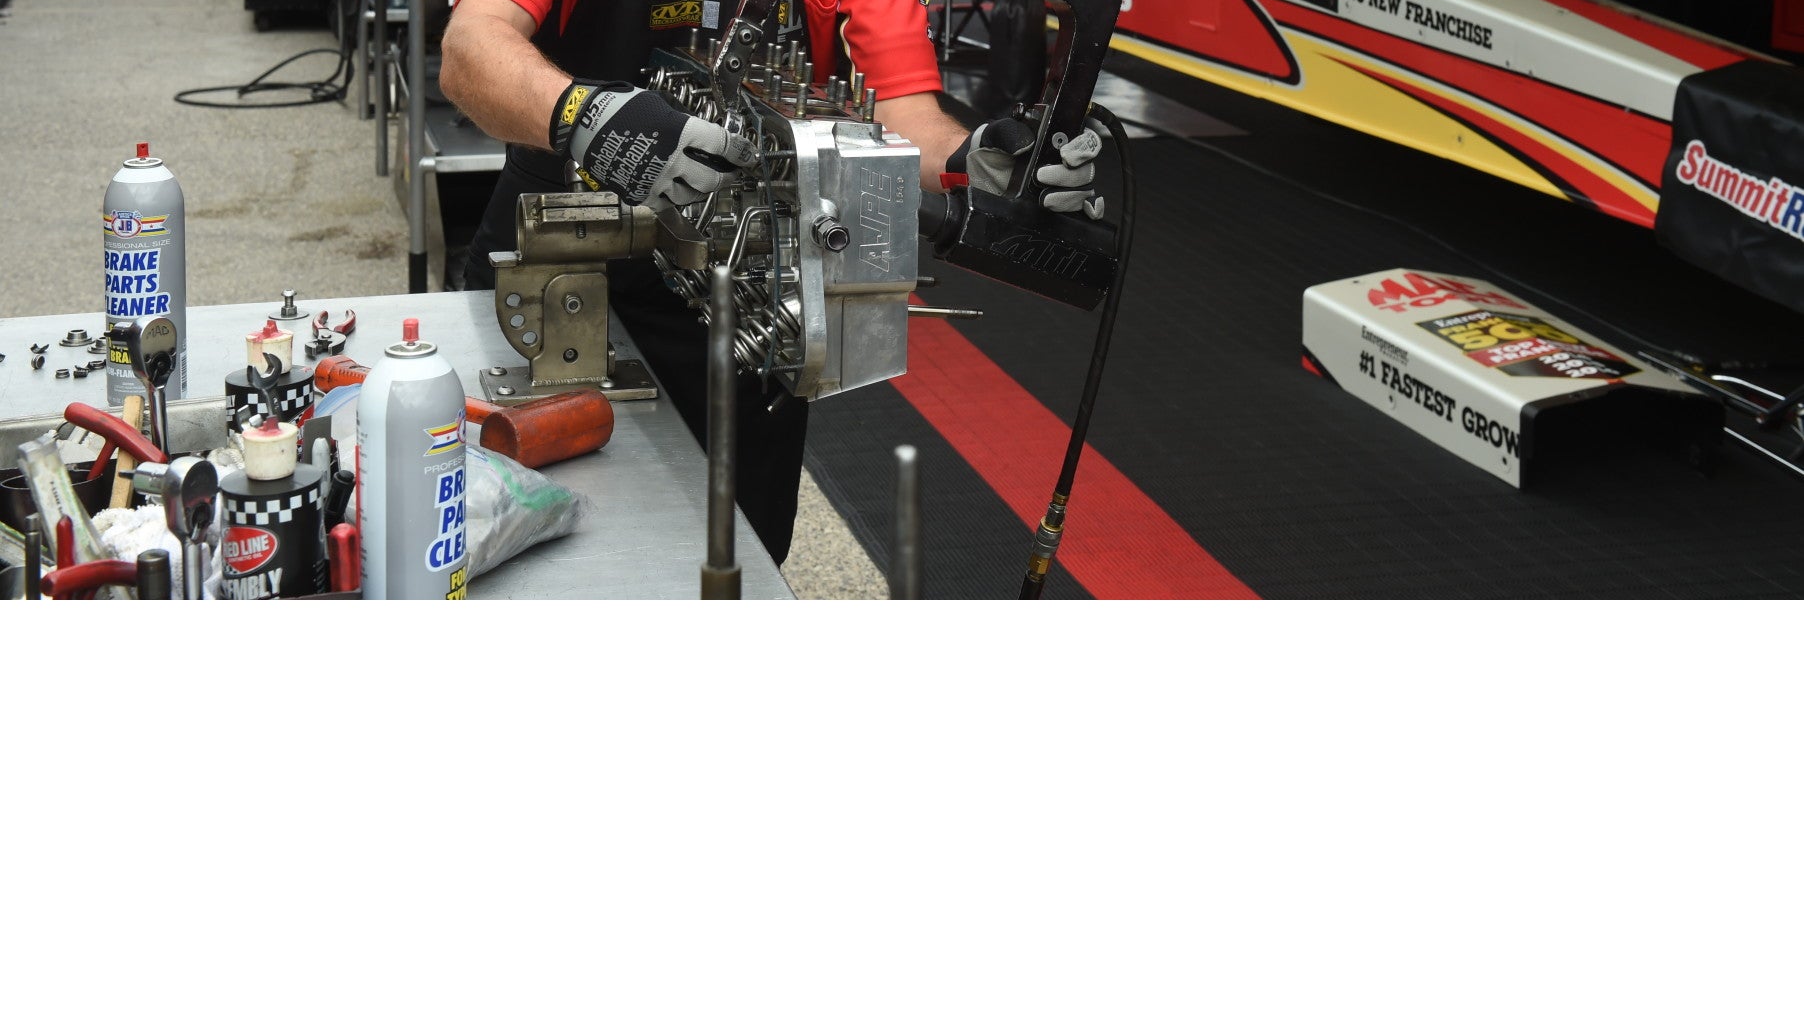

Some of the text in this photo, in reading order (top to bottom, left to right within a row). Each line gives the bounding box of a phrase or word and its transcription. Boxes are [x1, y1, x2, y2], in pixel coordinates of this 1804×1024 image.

[1405, 0, 1493, 50] FRANCHISE
[590, 129, 626, 179] Mechanix
[610, 132, 654, 189] Mechanix
[1678, 141, 1804, 239] SummitR
[118, 220, 132, 232] JB
[860, 167, 891, 272] AJPE
[152, 238, 171, 247] SIZE
[105, 250, 159, 272] BRAKE
[106, 273, 158, 294] PARTS
[105, 294, 169, 316] LEANER
[110, 349, 132, 364] BRA
[1488, 340, 1534, 355] TOP
[1360, 351, 1520, 458] #1 FASTEST GROW
[424, 454, 466, 475] PROFES
[241, 534, 270, 556] LINE
[222, 567, 284, 600] EMBLY
